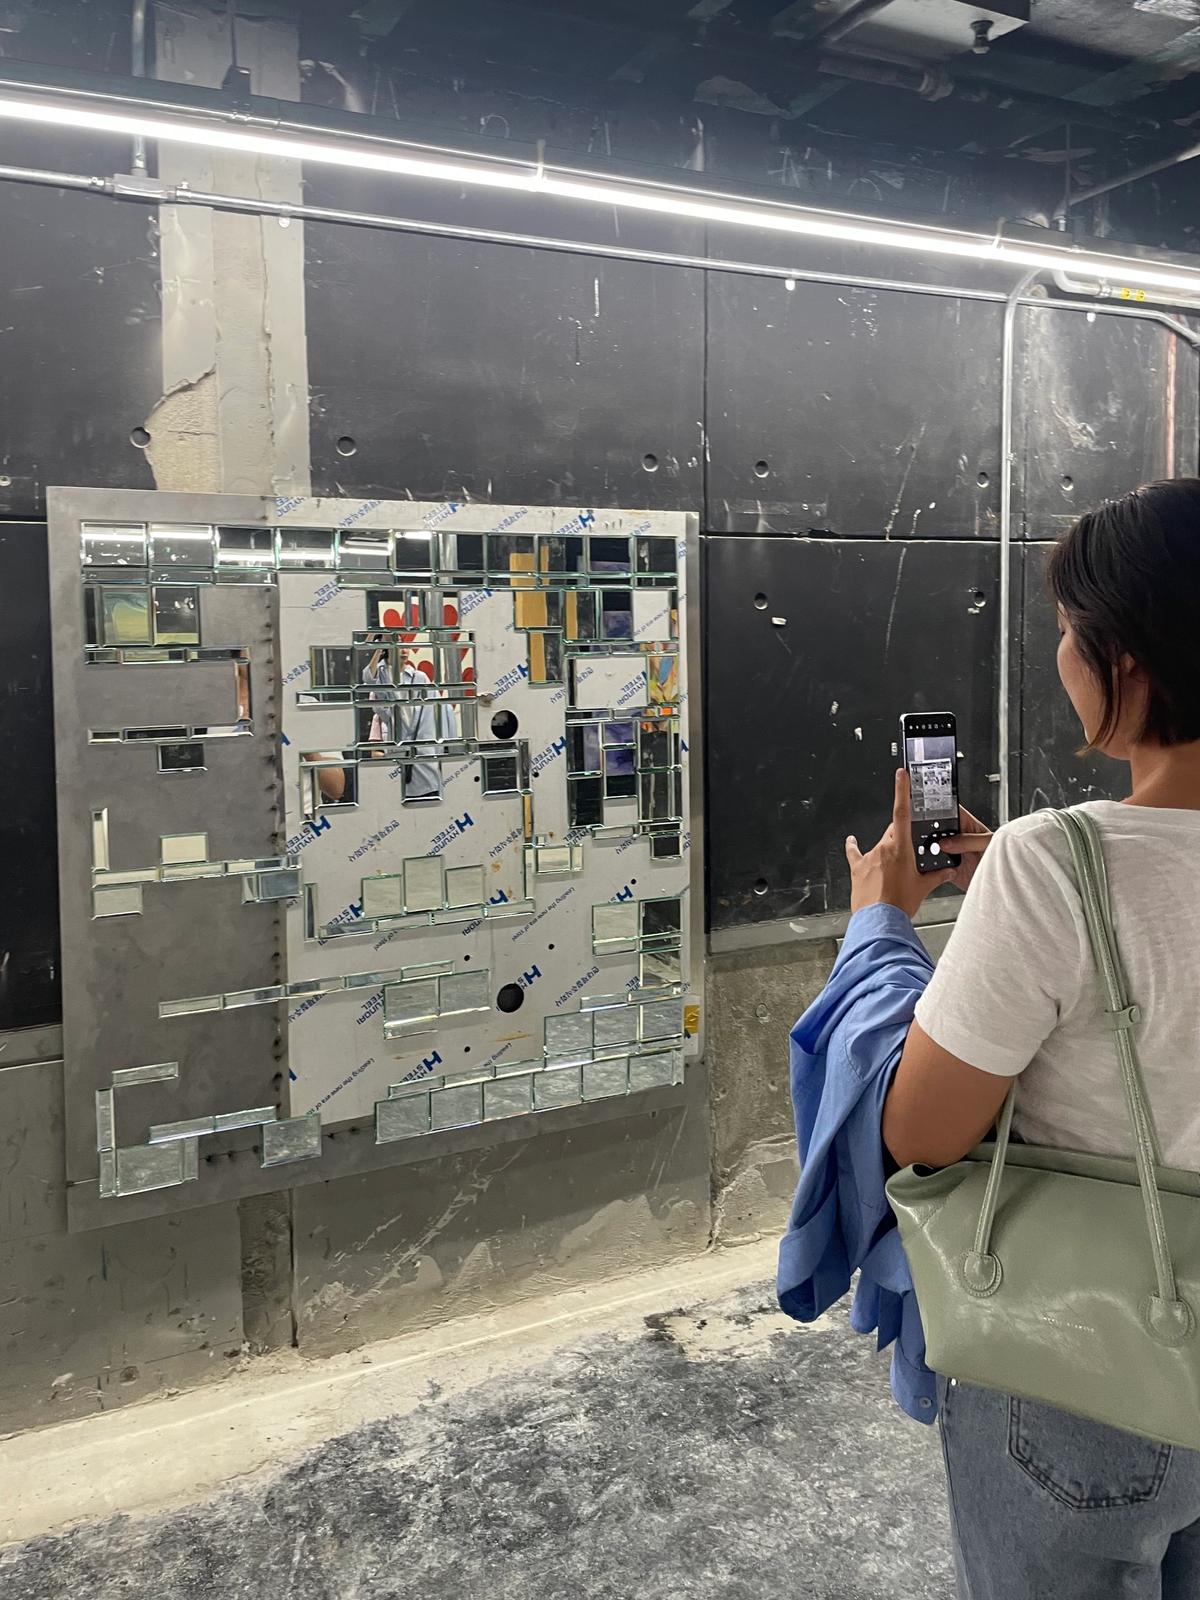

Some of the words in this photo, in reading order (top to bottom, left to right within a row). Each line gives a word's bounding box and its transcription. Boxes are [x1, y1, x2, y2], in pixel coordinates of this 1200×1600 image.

[313, 578, 336, 599] TEEL
[494, 667, 518, 688] STEEL
[620, 674, 642, 694] STEEL
[615, 679, 646, 706] HYUNDAI
[429, 823, 456, 846] STEEL
[553, 885, 576, 905] Leading
[535, 908, 548, 920] new
[546, 901, 557, 912] the
[527, 917, 538, 927] era
[510, 928, 525, 942] steel
[552, 965, 601, 1007] 현대제철주식회사
[350, 1056, 375, 1078] Leading
[329, 1083, 343, 1096] new
[341, 1075, 354, 1087] the
[320, 1093, 332, 1104] era
